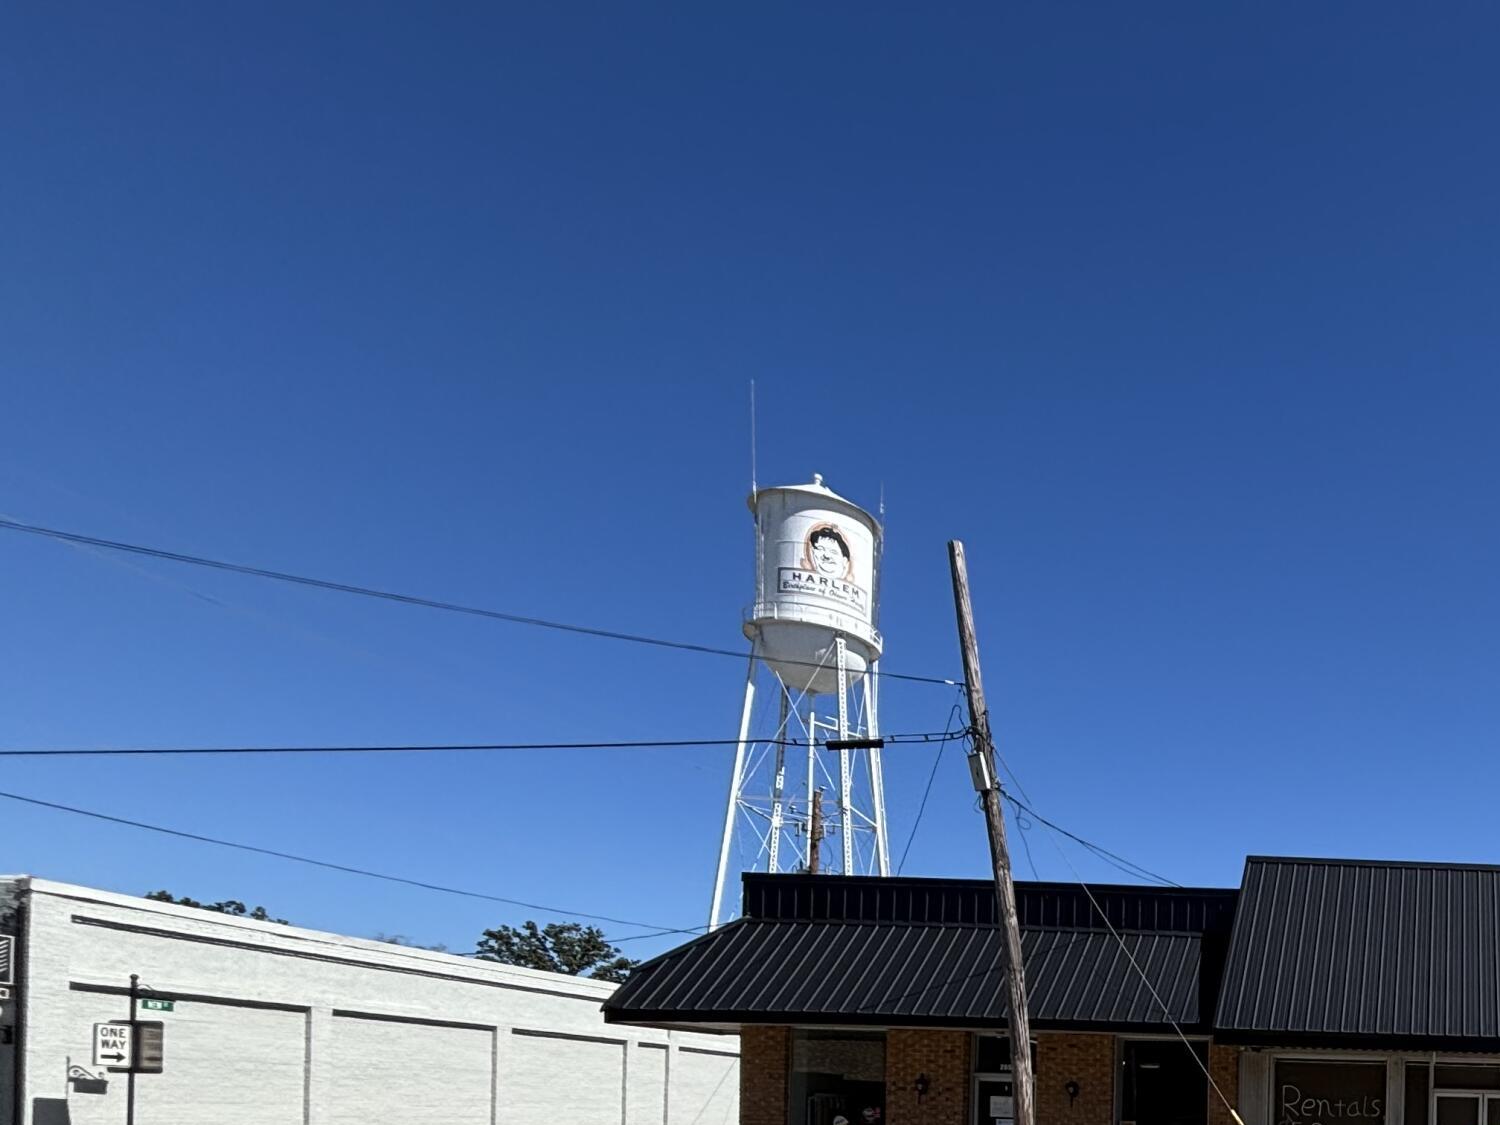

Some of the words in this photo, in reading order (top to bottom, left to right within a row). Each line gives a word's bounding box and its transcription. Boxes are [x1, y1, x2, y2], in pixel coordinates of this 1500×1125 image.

[792, 572, 860, 599] HARLEM
[100, 1027, 126, 1038] ONE
[101, 1039, 126, 1049] WAY
[1282, 1084, 1382, 1118] Rentals
